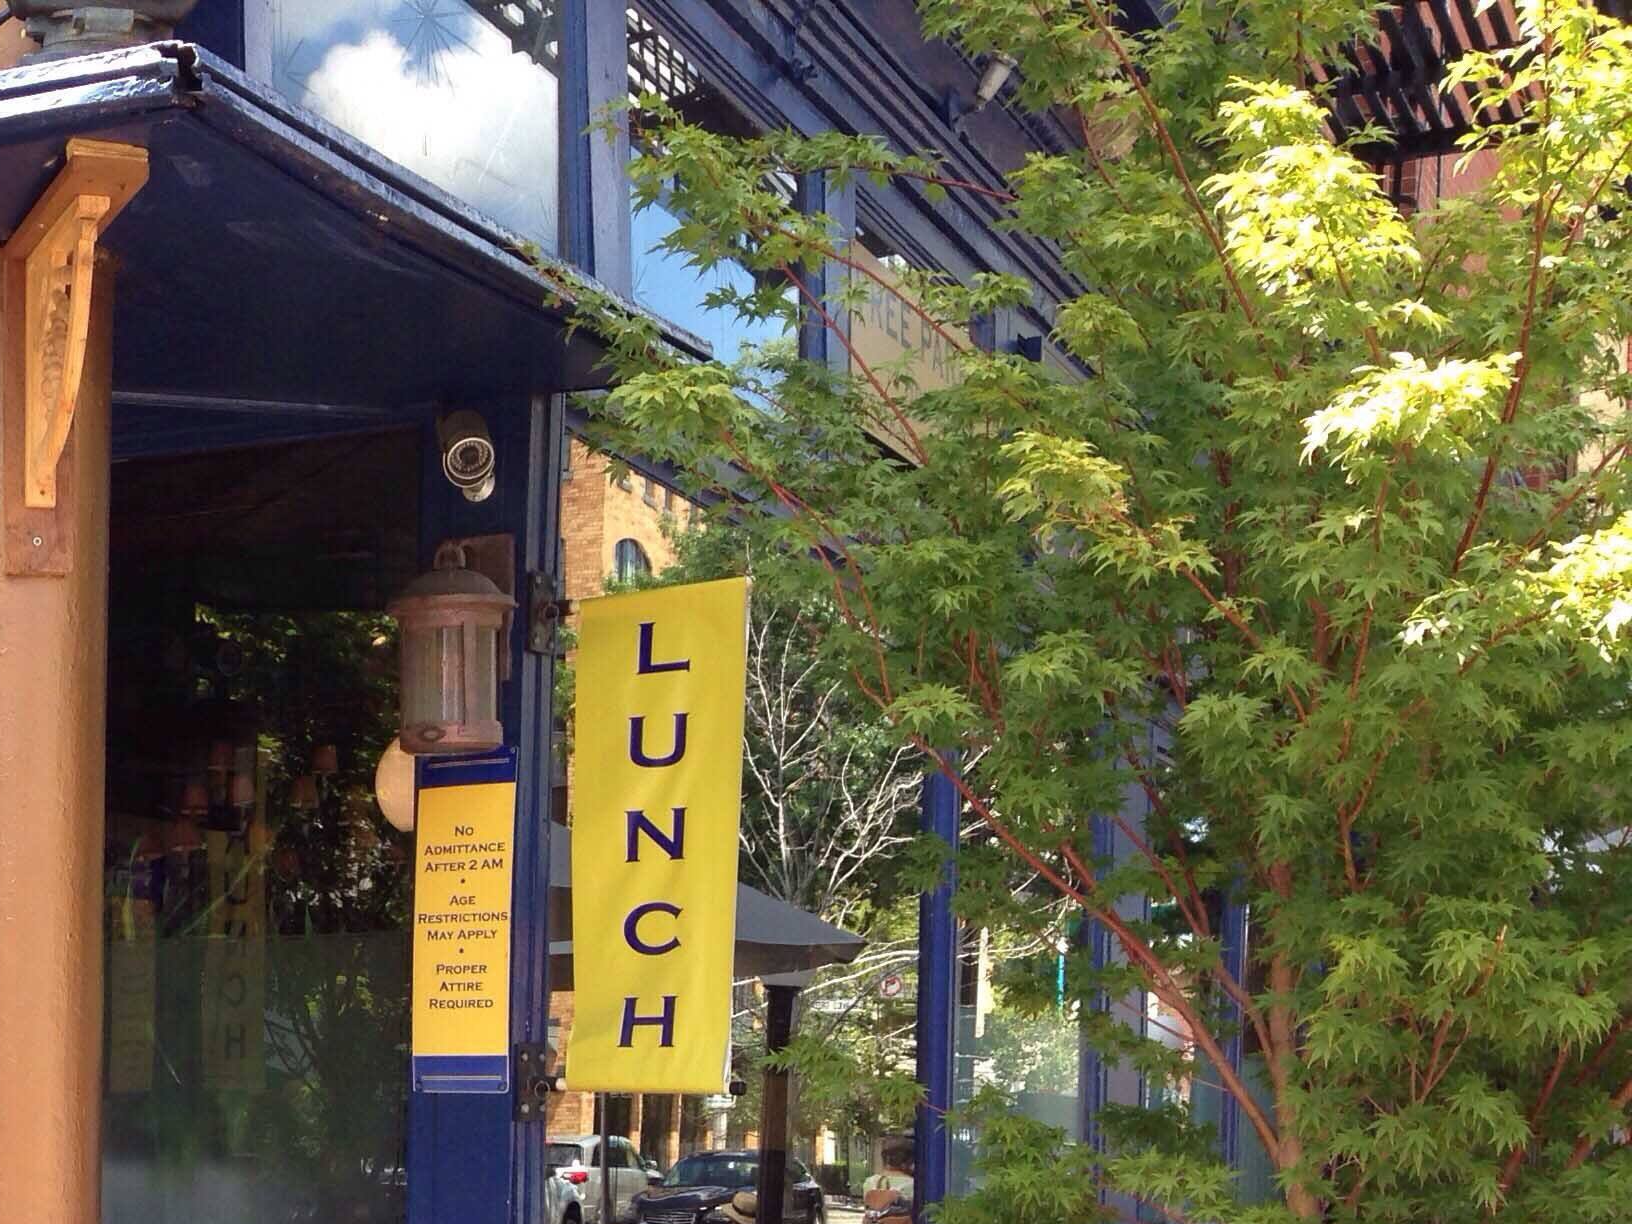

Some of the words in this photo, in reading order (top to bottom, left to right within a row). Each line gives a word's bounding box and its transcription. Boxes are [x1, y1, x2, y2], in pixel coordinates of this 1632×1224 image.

[454, 825, 474, 837] NO
[617, 621, 690, 1048] LUNCH
[424, 842, 506, 856] ADMITTANCE
[425, 861, 466, 873] AFTER
[468, 859, 478, 871] 2
[480, 858, 504, 870] AM
[449, 895, 477, 907] AGE
[418, 911, 509, 925] RESTRICTIONS
[426, 930, 454, 942] MAY
[456, 929, 498, 940] APPLY
[436, 963, 488, 976] PROPER
[439, 981, 484, 992] ATTIRE
[429, 998, 494, 1010] REQUIRED
